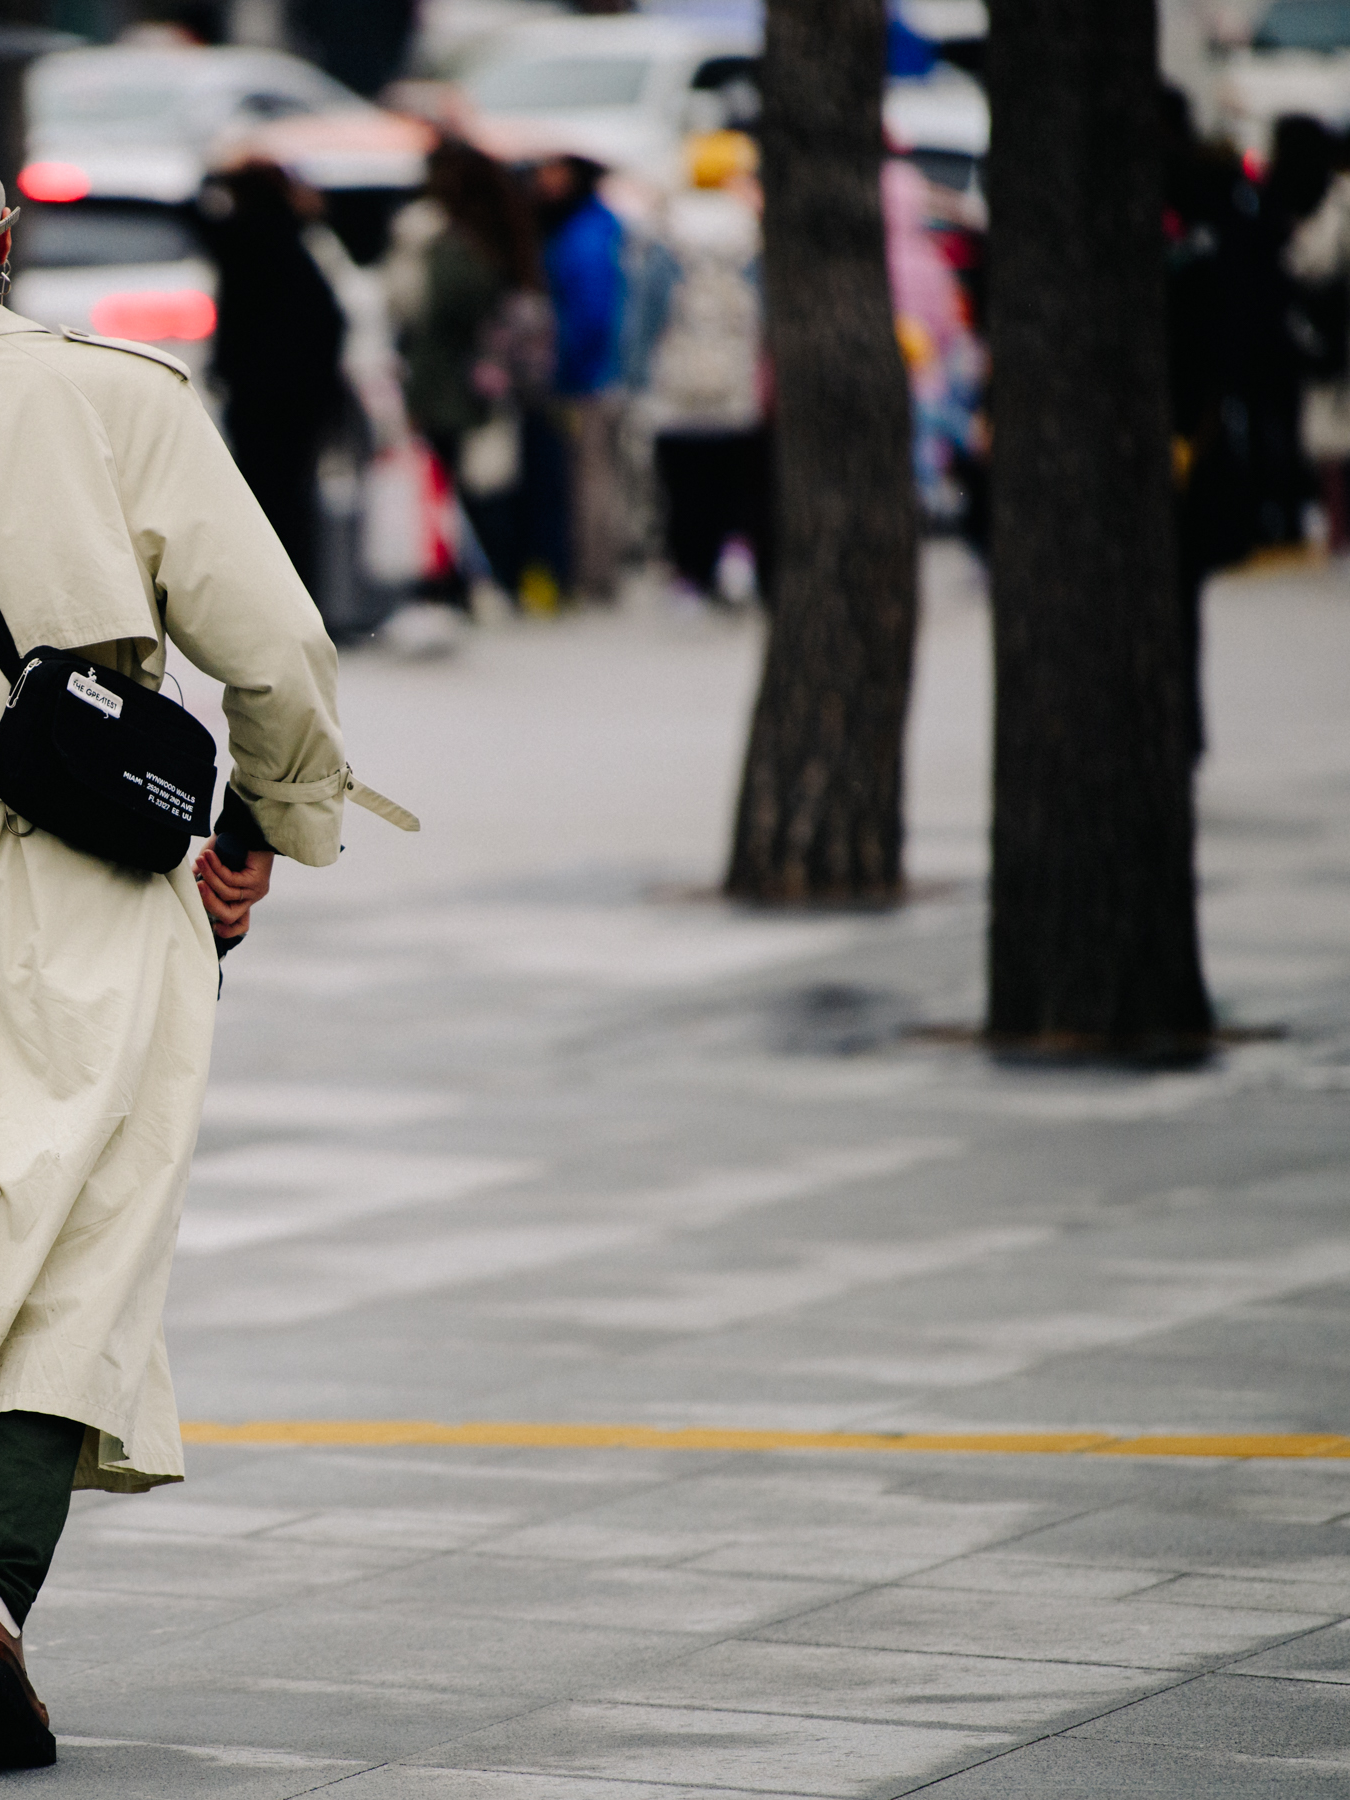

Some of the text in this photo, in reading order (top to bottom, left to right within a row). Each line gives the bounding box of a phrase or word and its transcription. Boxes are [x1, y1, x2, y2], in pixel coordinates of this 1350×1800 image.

[146, 771, 196, 803] WYNWOOD WALLS
[146, 783, 160, 795] 2520
[159, 790, 170, 800] NW
[169, 796, 181, 806] 2ND
[180, 802, 194, 812] AVE
[148, 794, 155, 803] FL
